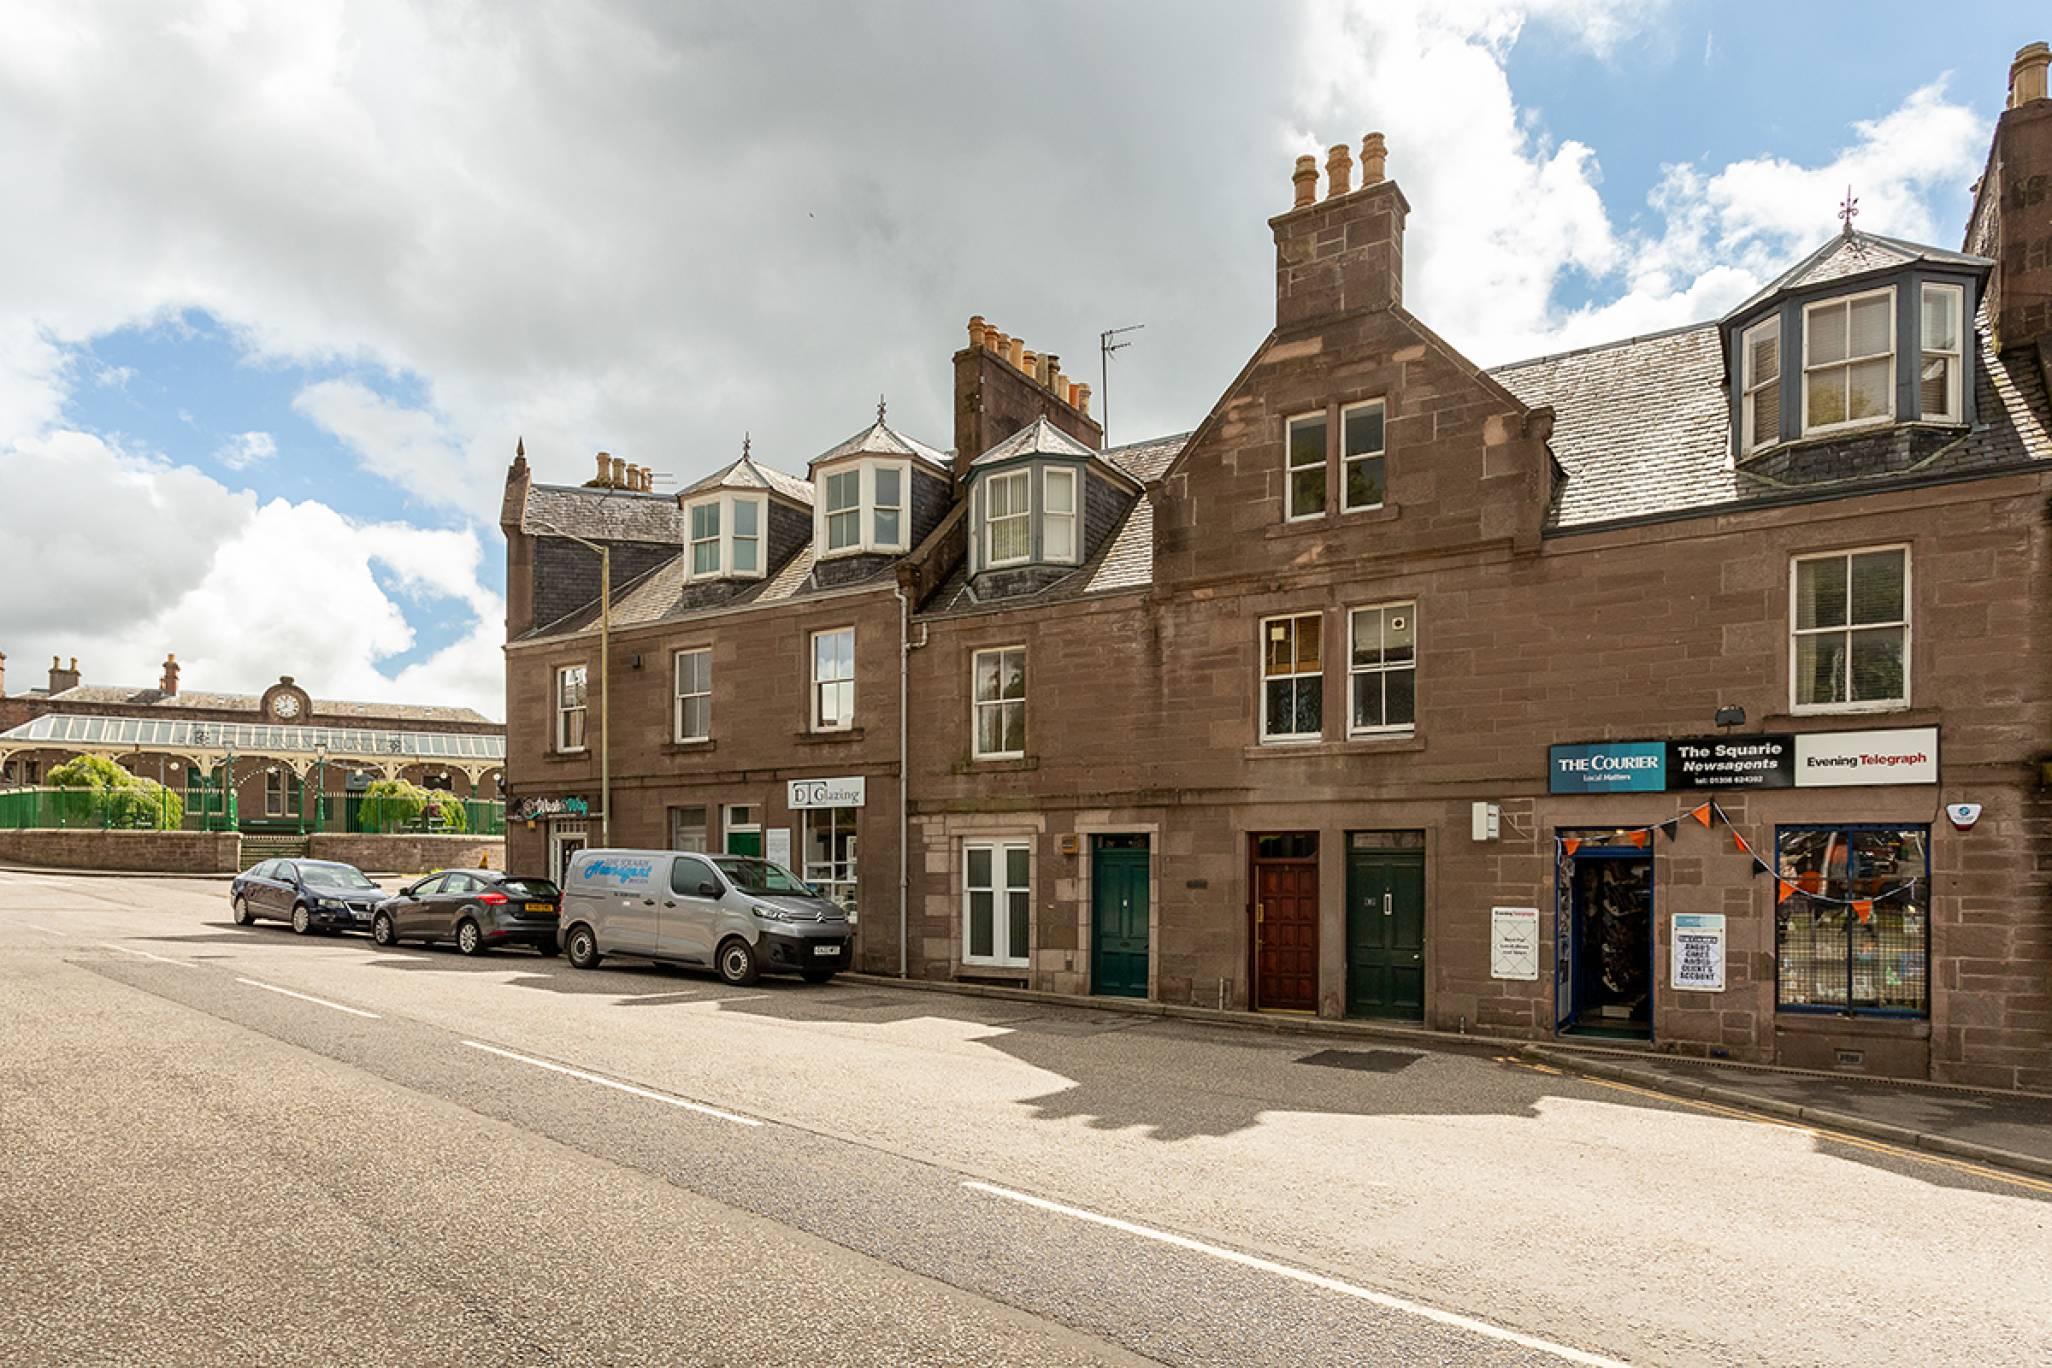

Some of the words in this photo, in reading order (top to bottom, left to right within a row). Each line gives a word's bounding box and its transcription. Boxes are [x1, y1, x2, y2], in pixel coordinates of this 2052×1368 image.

[1677, 746, 1711, 759] The
[1714, 742, 1783, 759] Squarie
[1558, 758, 1590, 772] THE
[1591, 753, 1659, 771] COURIER
[1683, 758, 1779, 772] Newsagents
[1807, 755, 1858, 769] Evening
[1858, 752, 1928, 767] Telegraph
